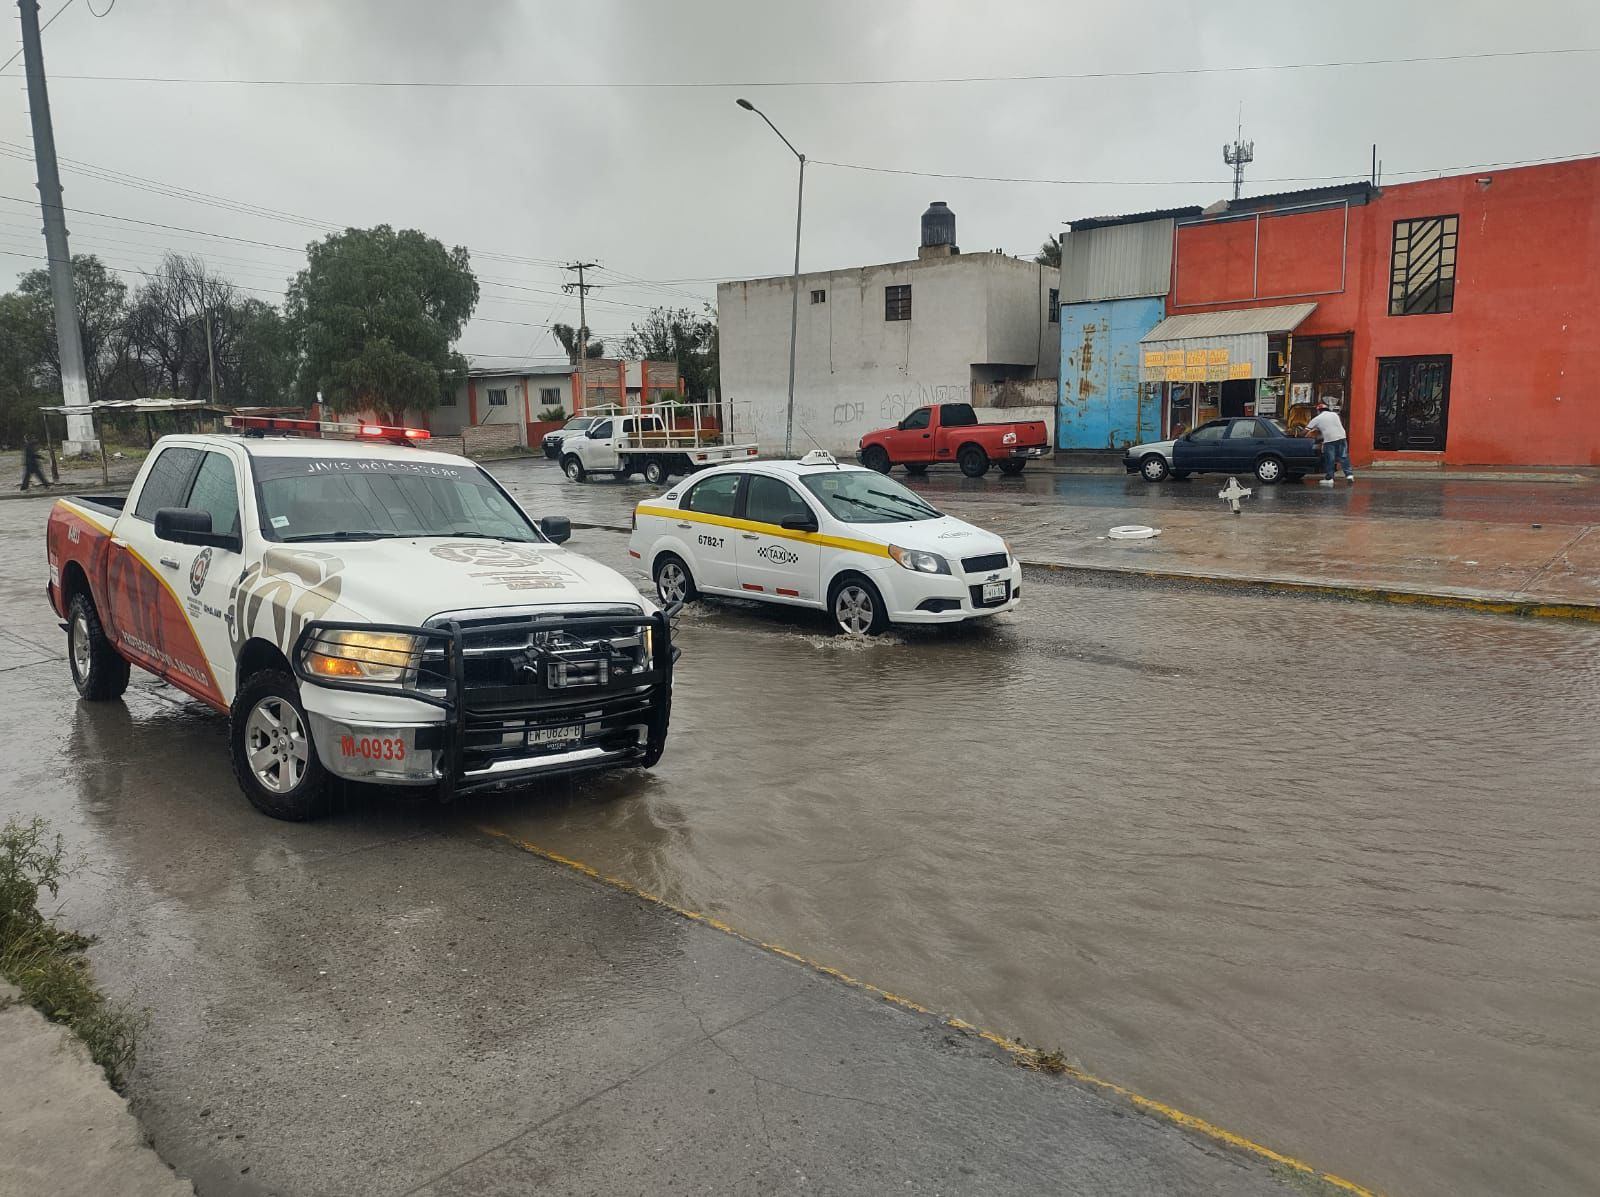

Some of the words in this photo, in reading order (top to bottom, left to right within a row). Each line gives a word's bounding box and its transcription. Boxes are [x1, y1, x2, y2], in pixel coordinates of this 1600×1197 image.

[698, 534, 725, 548] 6782-T
[769, 549, 787, 561] TAXI
[341, 735, 406, 761] M-0933
